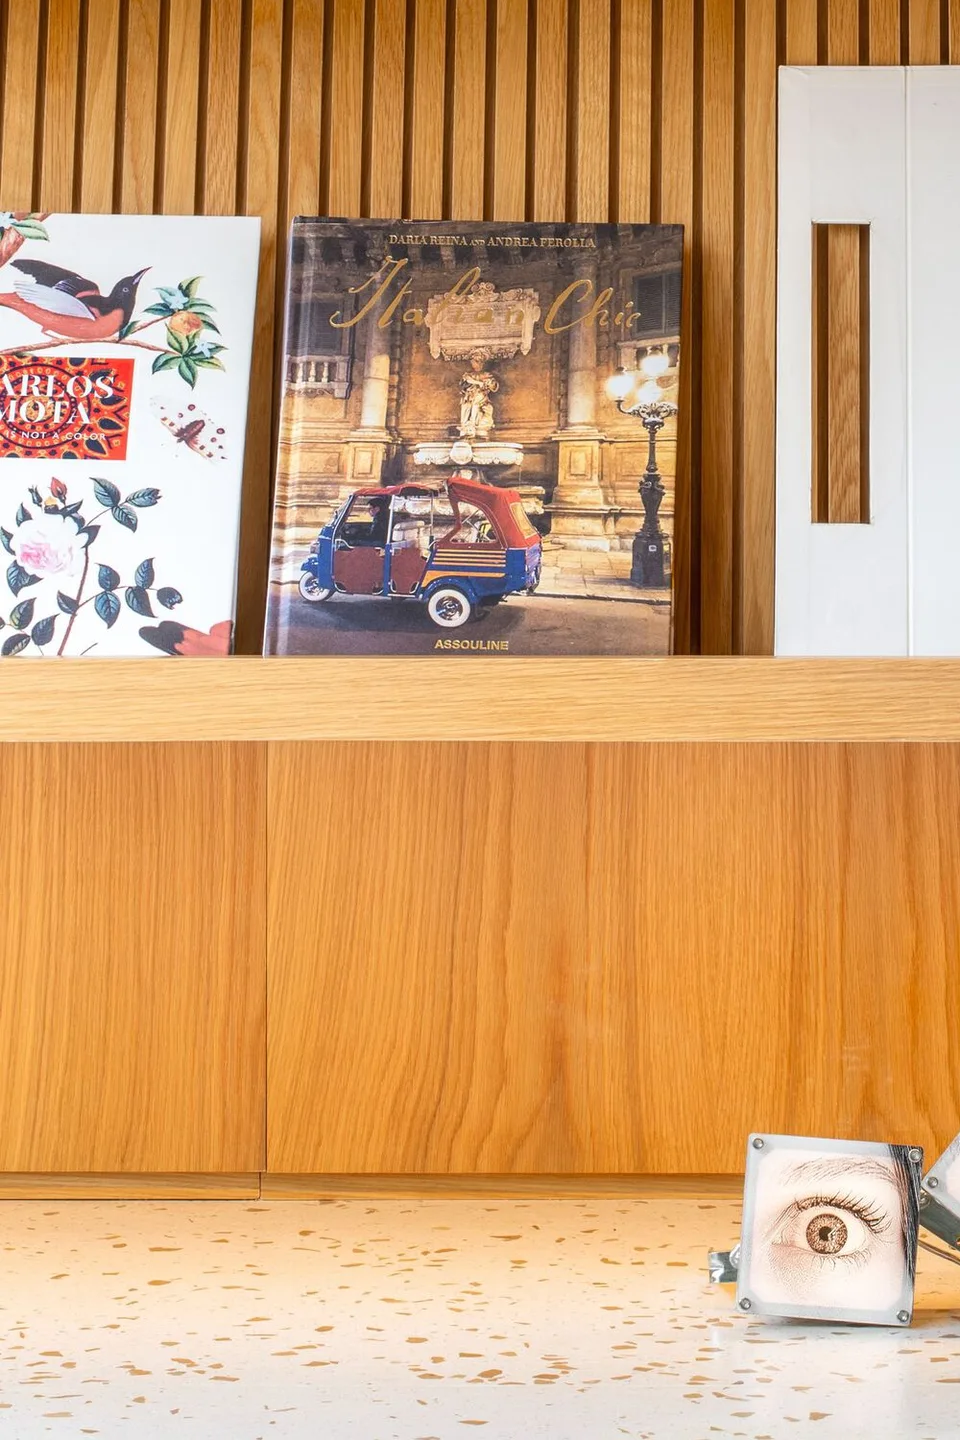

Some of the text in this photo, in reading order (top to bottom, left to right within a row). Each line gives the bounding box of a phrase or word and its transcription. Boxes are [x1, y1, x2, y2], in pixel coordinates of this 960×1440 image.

[388, 233, 597, 249] DARIA REINA AND ANDREA FEROLLA
[329, 254, 643, 336] Italian Chic
[0, 373, 116, 399] ARLOS
[5, 431, 107, 441] IS NOT A COLOR
[434, 638, 509, 651] ASSOULINE
